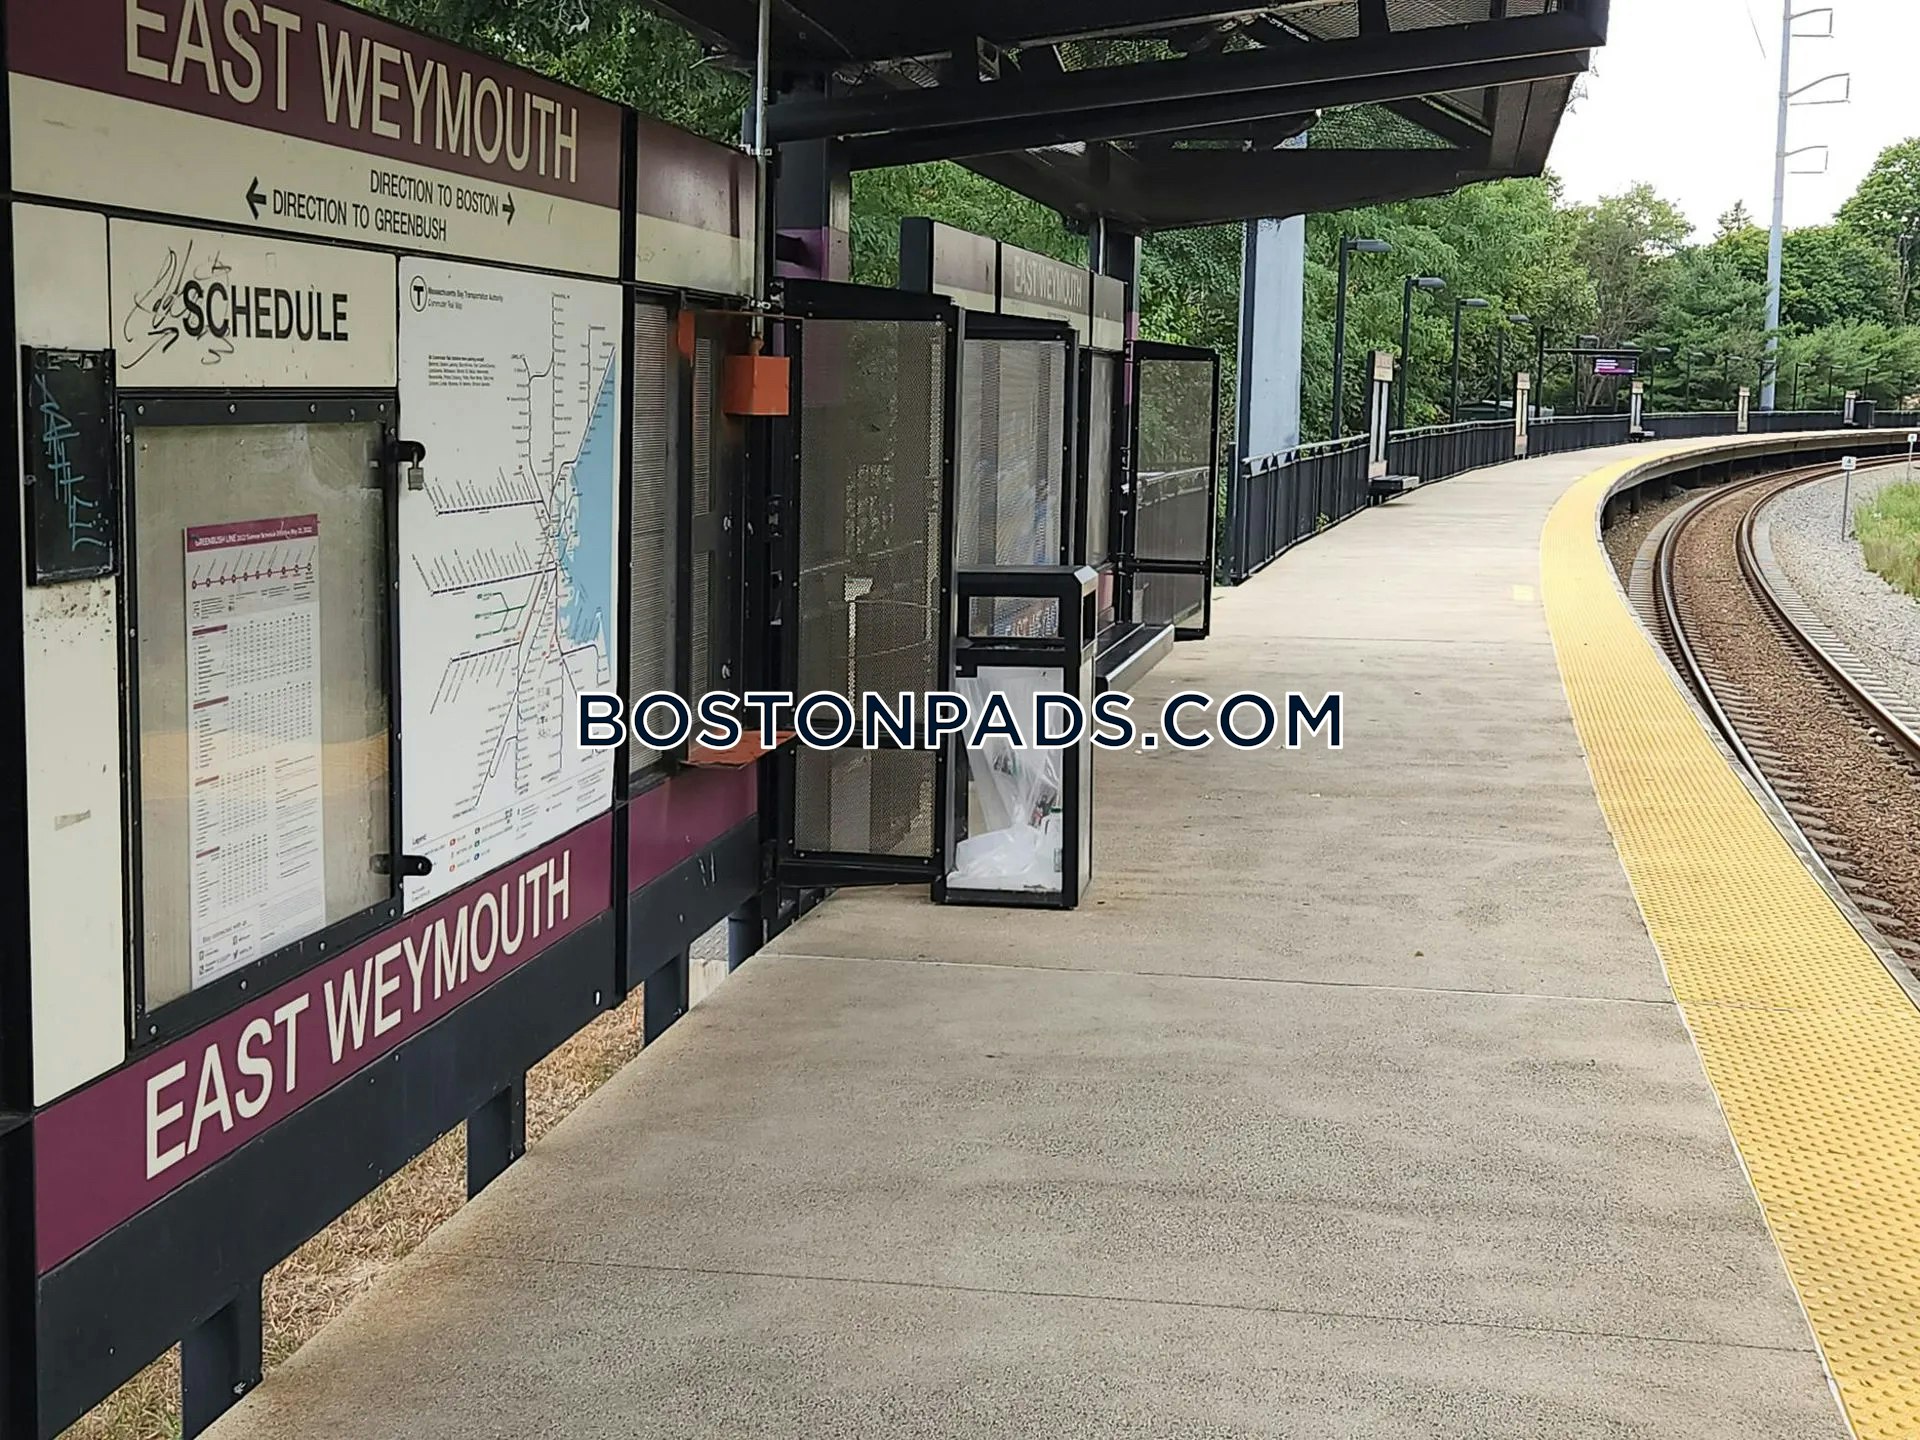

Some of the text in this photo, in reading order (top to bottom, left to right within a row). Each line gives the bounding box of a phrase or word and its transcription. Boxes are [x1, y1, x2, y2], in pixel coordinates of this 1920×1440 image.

[126, 0, 578, 183] EAST WEYMOUTH
[273, 189, 447, 241] DIRECTION TO GREENBUSH
[370, 169, 499, 216] DIRECTION TO BOSTON
[183, 279, 349, 342] SCHEDULE
[1014, 255, 1082, 308] EAST WEYMOUTH
[147, 850, 570, 1180] EAST WEYMOUTH
